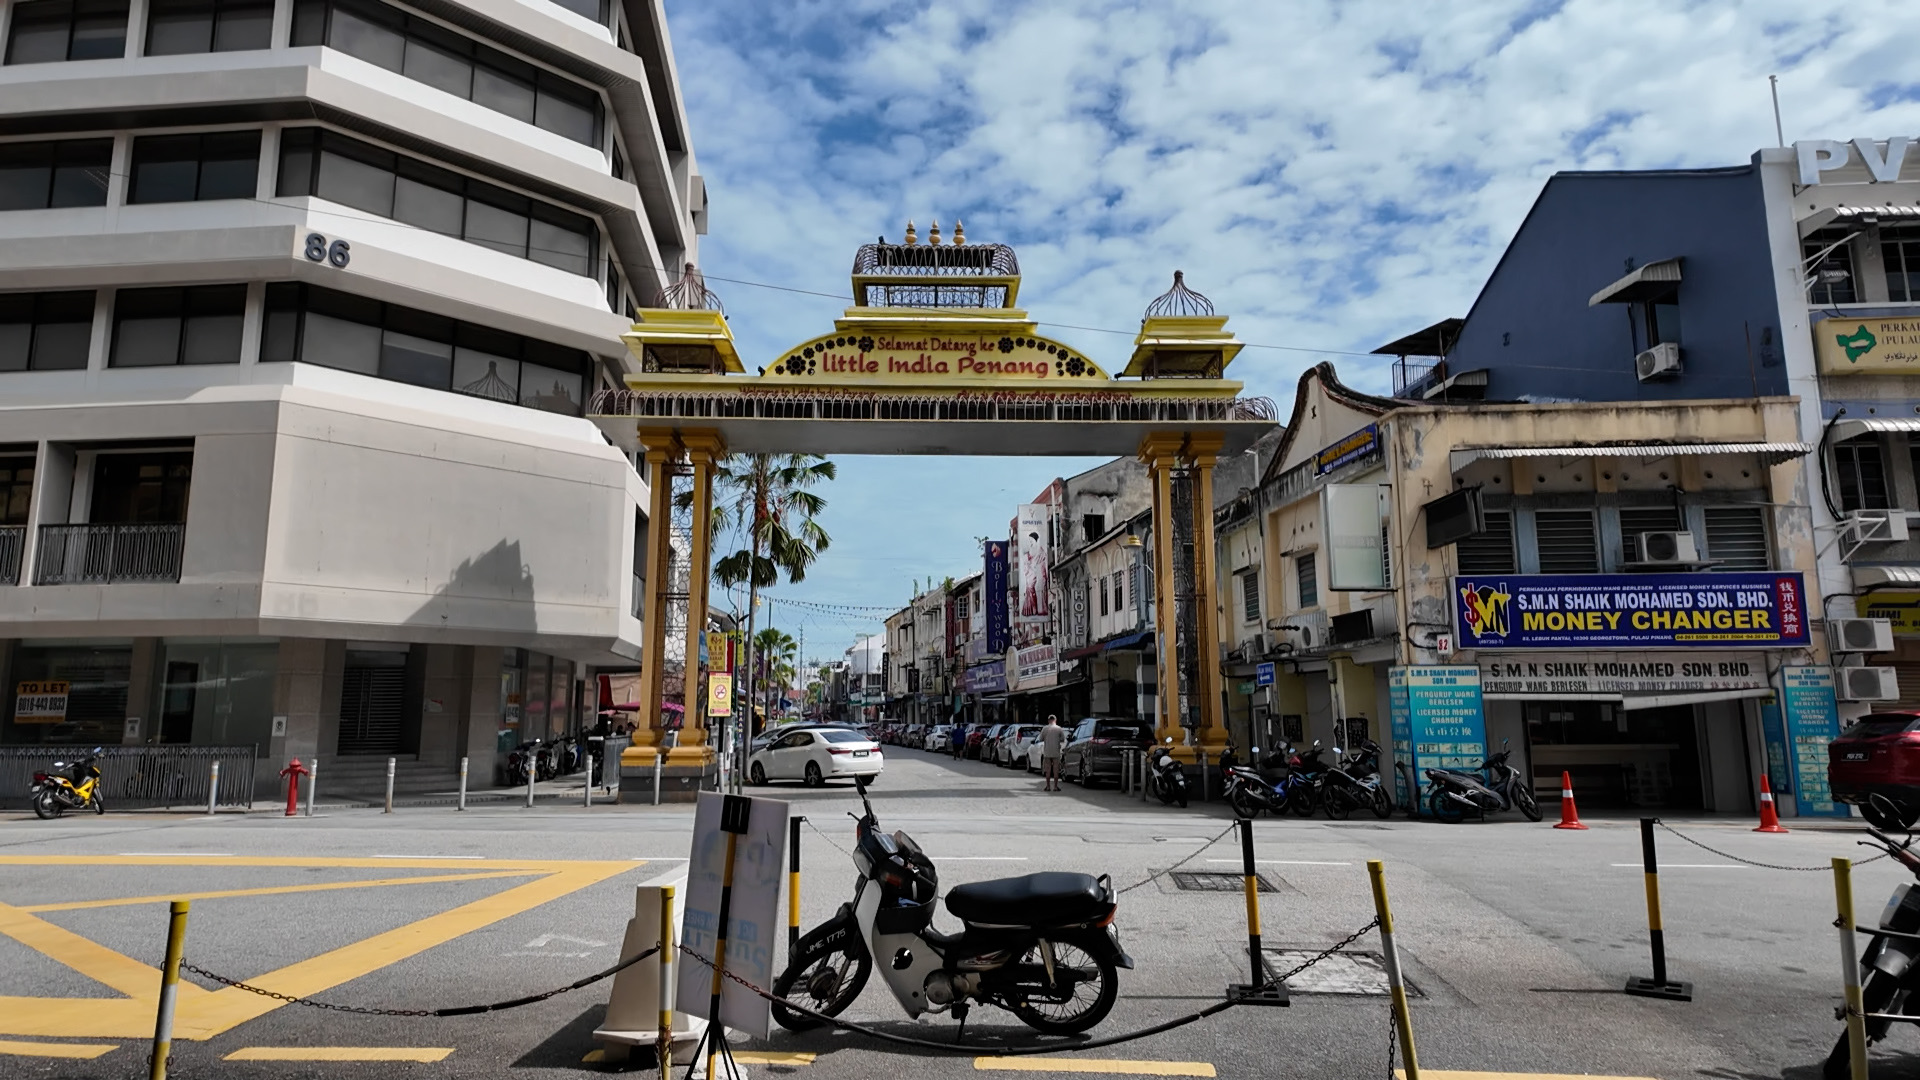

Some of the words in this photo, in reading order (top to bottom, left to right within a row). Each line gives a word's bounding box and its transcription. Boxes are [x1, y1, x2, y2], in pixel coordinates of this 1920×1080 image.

[304, 233, 350, 268] 86
[877, 337, 928, 351] Selamat
[930, 337, 977, 356] Datang
[980, 336, 995, 351] ke
[888, 354, 949, 374] India
[958, 356, 1049, 378] Penang
[1518, 594, 1559, 610] S.M.N
[1565, 593, 1610, 610] SHAIK
[1614, 592, 1693, 609] MOHAMED
[1697, 592, 1734, 608] SDN.
[1738, 591, 1773, 608] BHD.
[1074, 590, 1084, 648] HOTEL
[1523, 612, 1622, 631] MONEY
[1631, 610, 1771, 630] CHANGER
[1430, 669, 1446, 677] SHAIK
[1448, 669, 1478, 677] MOHAMED
[1544, 662, 1588, 677] SHAIK
[1595, 663, 1673, 677] MOHAMED
[1719, 663, 1752, 677] BHD.
[21, 683, 39, 693] TO
[43, 683, 67, 693] LET
[1484, 681, 1522, 692] PENGURUP
[1526, 681, 1548, 692] WANG
[1551, 681, 1588, 692] BERLESEN
[1598, 681, 1634, 691] LICENSED
[1638, 681, 1665, 691] MONEY
[1669, 681, 1704, 690] CHANGER
[1428, 698, 1464, 706] BERLESEN
[1416, 708, 1450, 716] LICENSED
[1452, 708, 1477, 716] MONEY
[1431, 716, 1464, 724] CHANGER
[826, 928, 846, 944] 1775
